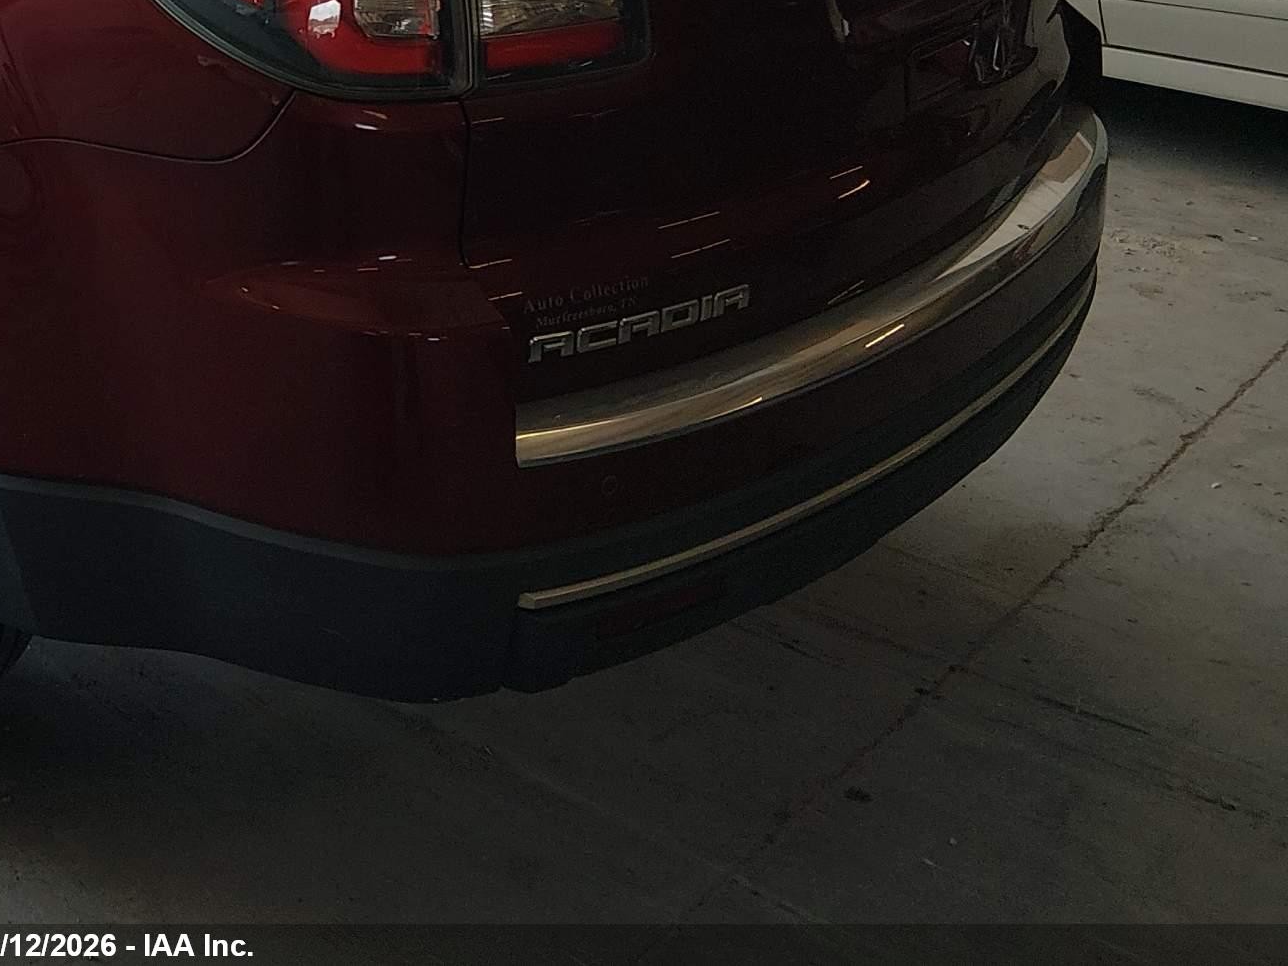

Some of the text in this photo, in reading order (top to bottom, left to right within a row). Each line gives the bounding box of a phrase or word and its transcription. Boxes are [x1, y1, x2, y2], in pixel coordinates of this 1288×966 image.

[523, 274, 649, 315] Auto Collection
[528, 284, 752, 364] ACADIA
